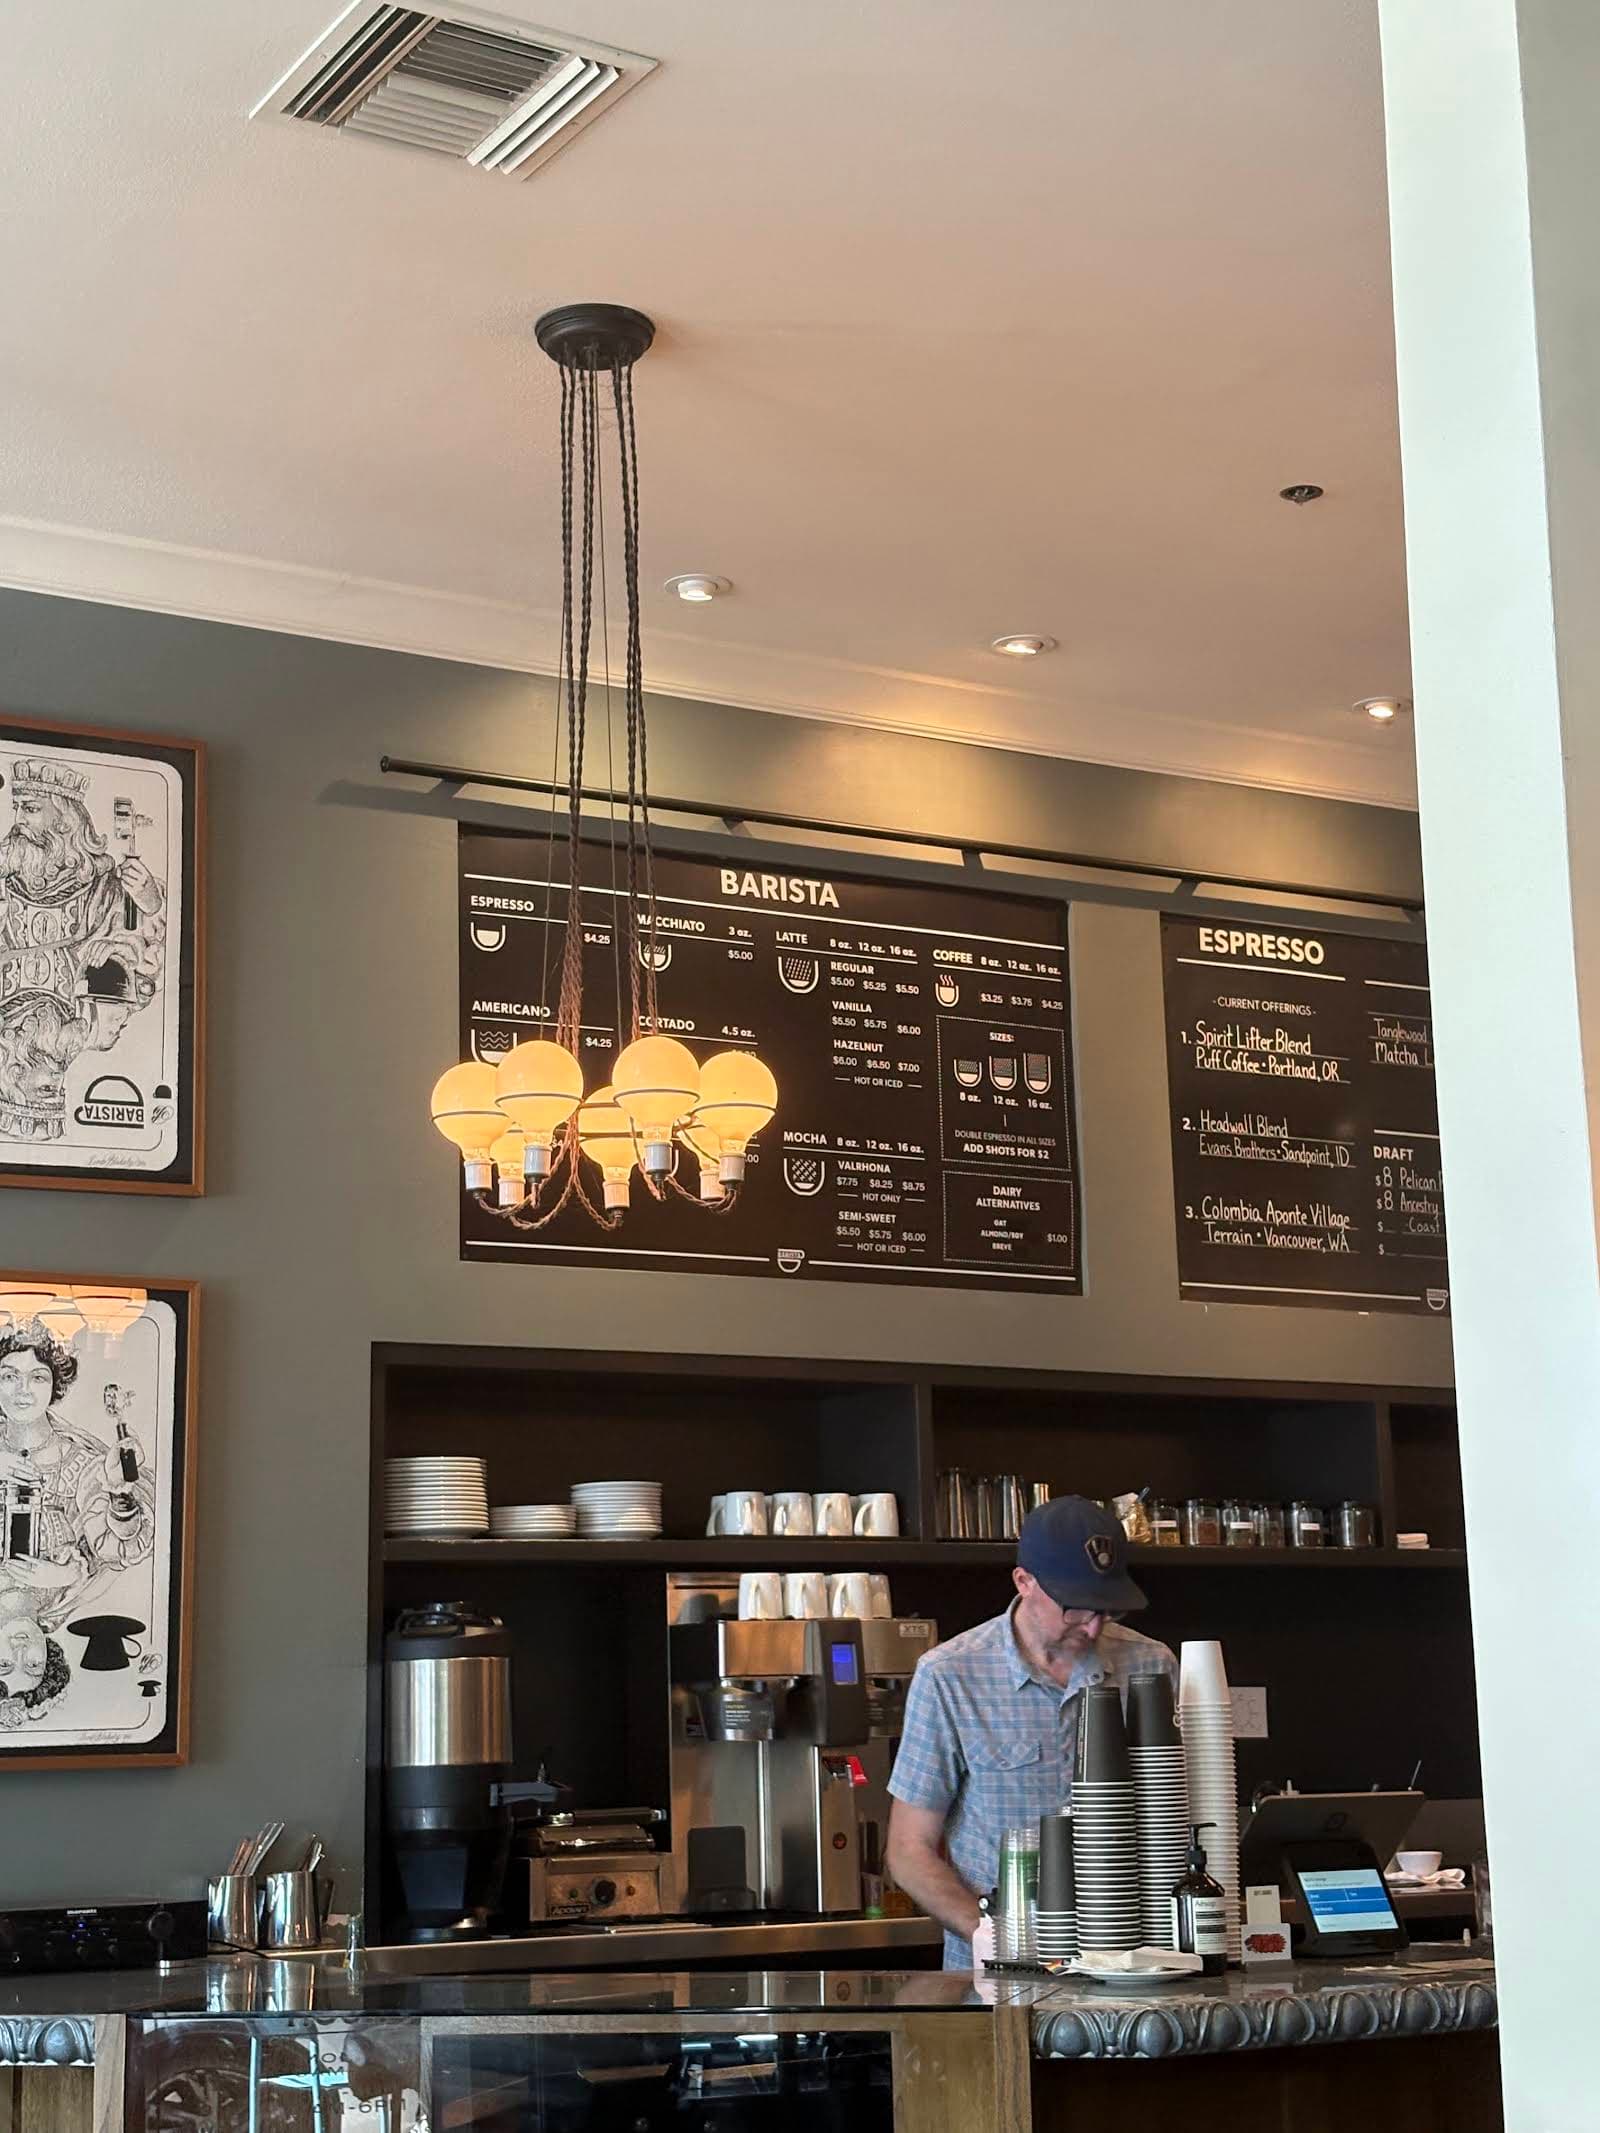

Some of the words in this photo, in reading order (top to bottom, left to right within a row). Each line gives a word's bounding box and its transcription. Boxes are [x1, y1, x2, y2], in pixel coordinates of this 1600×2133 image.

[720, 869, 840, 908] BARISTA
[471, 895, 534, 911] ESPRESSO
[584, 933, 610, 944] $4.25
[728, 926, 735, 935] 3
[737, 929, 752, 937] oz.
[776, 931, 808, 944] LATTE
[830, 939, 836, 947] 8
[838, 941, 852, 949] oz.
[858, 941, 869, 952] 12
[870, 945, 885, 954] oz.
[890, 945, 901, 955] 16
[902, 948, 917, 957] oz.
[1199, 926, 1325, 965] ESPRESSO
[728, 950, 753, 960] $5.00
[933, 949, 973, 964] COFFEE
[980, 956, 987, 965] 8
[988, 959, 1002, 968] oz.
[1007, 960, 1018, 969] 12
[1019, 963, 1032, 971] oz.
[1036, 963, 1046, 973] 16
[1048, 966, 1061, 975] oz.
[830, 961, 874, 974] REGULAR
[830, 976, 855, 987] $5.00
[862, 980, 887, 991] $5.25
[895, 983, 919, 995] $5.50
[472, 1001, 550, 1017] AMERICANO
[832, 1000, 872, 1013] VANILLA
[980, 992, 1003, 1004] $3.25
[1041, 999, 1063, 1010] $4.25
[1217, 996, 1260, 1011] CURRENT
[1261, 1000, 1312, 1017] OFFERINGS
[722, 1025, 738, 1036] 4.5
[740, 1029, 755, 1038] oz.
[863, 1018, 887, 1029] $5.75
[1373, 1018, 1427, 1044] Tanglewood
[585, 1037, 612, 1048] $4.25
[989, 1032, 1015, 1043] SIZES:
[1181, 1031, 1191, 1045] 1.
[1195, 1020, 1232, 1050] Spirit
[1236, 1024, 1273, 1051] Lifter
[1276, 1029, 1311, 1055] Blend
[833, 1039, 884, 1053] HAZELNUT
[1375, 1041, 1419, 1065] Matcha
[898, 1062, 920, 1072] $7.00
[1196, 1047, 1222, 1069] Puff
[1223, 1051, 1260, 1074] Coffee
[1268, 1056, 1321, 1083] Portland,
[1322, 1061, 1340, 1082] OR
[854, 1076, 870, 1085] HOT
[872, 1078, 884, 1086] OR
[885, 1079, 903, 1088] ICED
[959, 1092, 966, 1101] 8
[967, 1094, 981, 1103] oz.
[993, 1095, 1003, 1105] 12
[1005, 1098, 1018, 1107] oz.
[1028, 1098, 1037, 1108] 16
[1039, 1101, 1052, 1110] oz.
[84, 1104, 144, 1122] BARISTA
[1182, 1117, 1196, 1131] 2.
[1200, 1109, 1252, 1136] Headwall
[1256, 1114, 1289, 1137] Blend
[783, 1131, 827, 1145] MOCHA
[837, 1137, 843, 1146] 8
[845, 1139, 860, 1148] oz.
[865, 1139, 877, 1150] 12
[879, 1142, 893, 1151] oz.
[898, 1142, 908, 1152] 16
[910, 1144, 924, 1154] oz.
[954, 1129, 982, 1140] DOUBLE
[983, 1132, 1016, 1143] ESPRESSO
[1017, 1135, 1025, 1144] IN
[1025, 1137, 1037, 1145] ALL
[963, 1143, 984, 1153] ADD
[985, 1145, 1015, 1156] SHOTS
[1017, 1148, 1036, 1158] FOR
[1037, 1150, 1049, 1160] $2
[1199, 1136, 1231, 1157] Evans
[1234, 1137, 1277, 1159] Brothers
[1280, 1141, 1334, 1168] Sandpoint,
[1335, 1145, 1350, 1166] ID
[1373, 1146, 1413, 1162] DRAFT
[838, 1160, 891, 1174] VALRHONA
[836, 1176, 858, 1187] $7.75
[1400, 1166, 1437, 1191] Pelican
[862, 1192, 879, 1202] HOT
[880, 1194, 901, 1203] ONLY
[992, 1185, 1022, 1197] DAIRY
[975, 1198, 1041, 1211] ALTERNATIVES
[1400, 1191, 1439, 1220] Ancestry
[838, 1211, 896, 1224] SEMI-SWEET
[1185, 1205, 1198, 1219] 3.
[1201, 1195, 1263, 1221] Colombia
[1266, 1200, 1308, 1226] Aponte
[1309, 1204, 1350, 1233] Village
[869, 1229, 892, 1240] $5.75
[1047, 1233, 1068, 1244] $1.00
[1204, 1222, 1253, 1245] Terrain
[1263, 1227, 1326, 1253] Vancouver,
[1328, 1233, 1350, 1252] WA
[857, 1242, 874, 1252] HOT
[875, 1244, 886, 1253] OR
[888, 1244, 907, 1254] ICED
